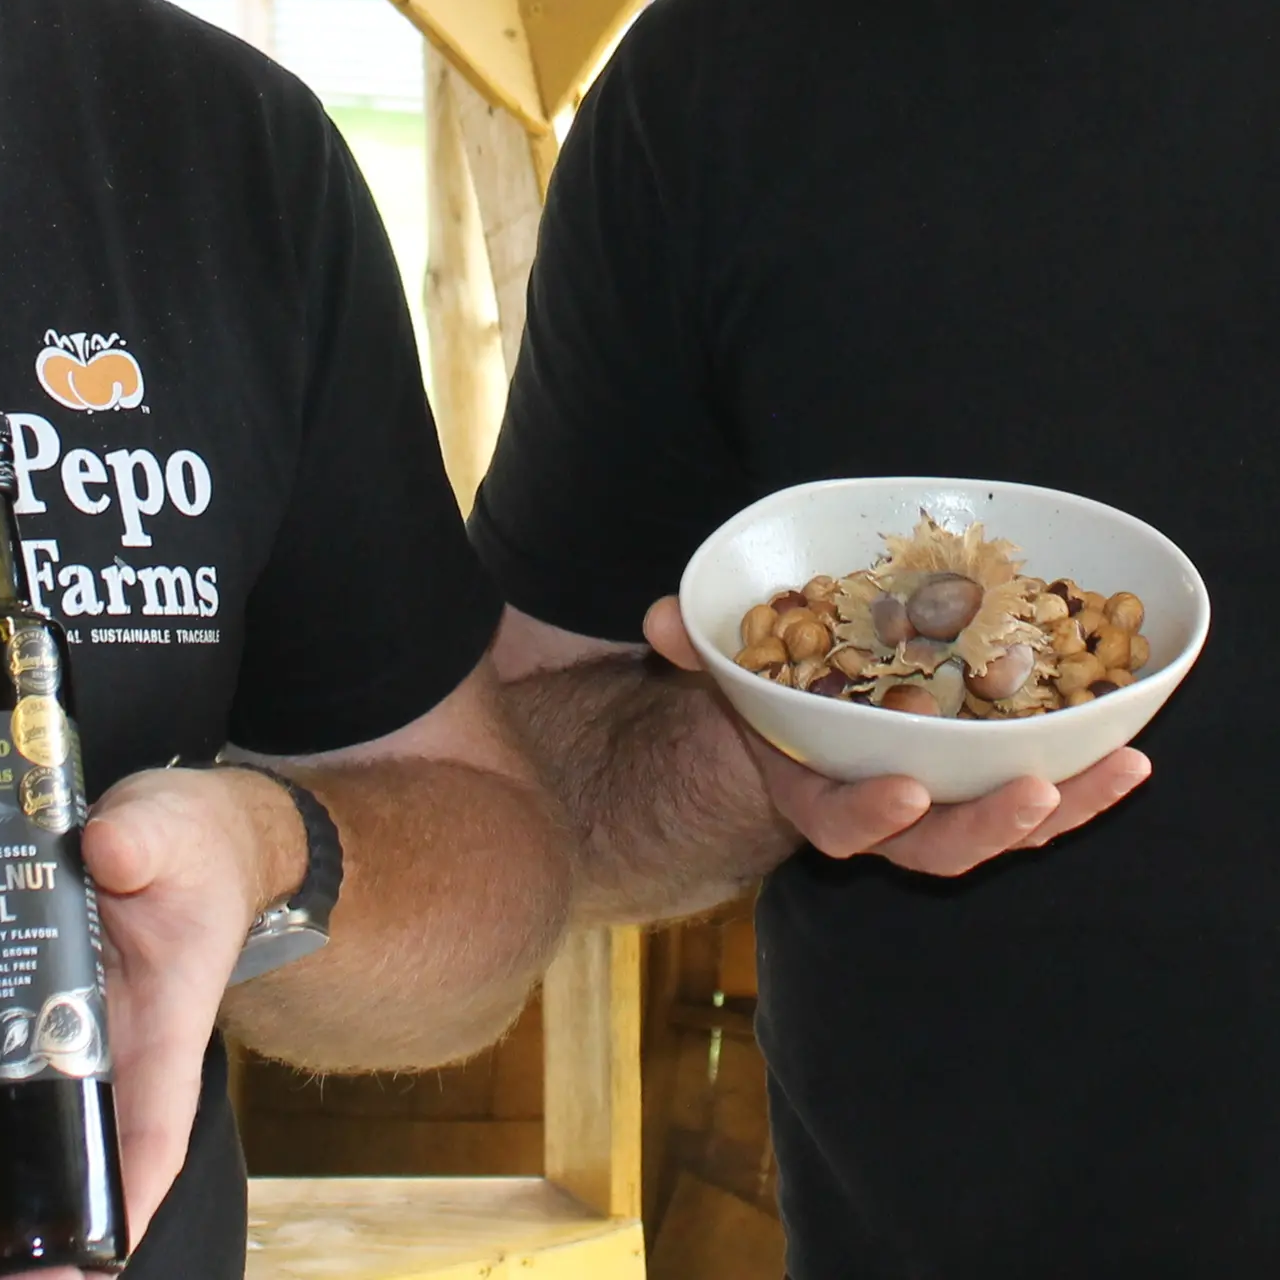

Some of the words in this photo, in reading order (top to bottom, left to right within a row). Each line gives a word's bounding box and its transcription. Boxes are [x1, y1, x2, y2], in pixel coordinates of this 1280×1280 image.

[6, 412, 213, 548] Pepo
[21, 539, 220, 619] Farms
[91, 628, 171, 644] SUSTAINABLE
[176, 629, 220, 644] TRACEABLE
[11, 927, 59, 940] FLAVOUR
[2, 946, 38, 958] GROWN
[13, 960, 37, 972] FREE
